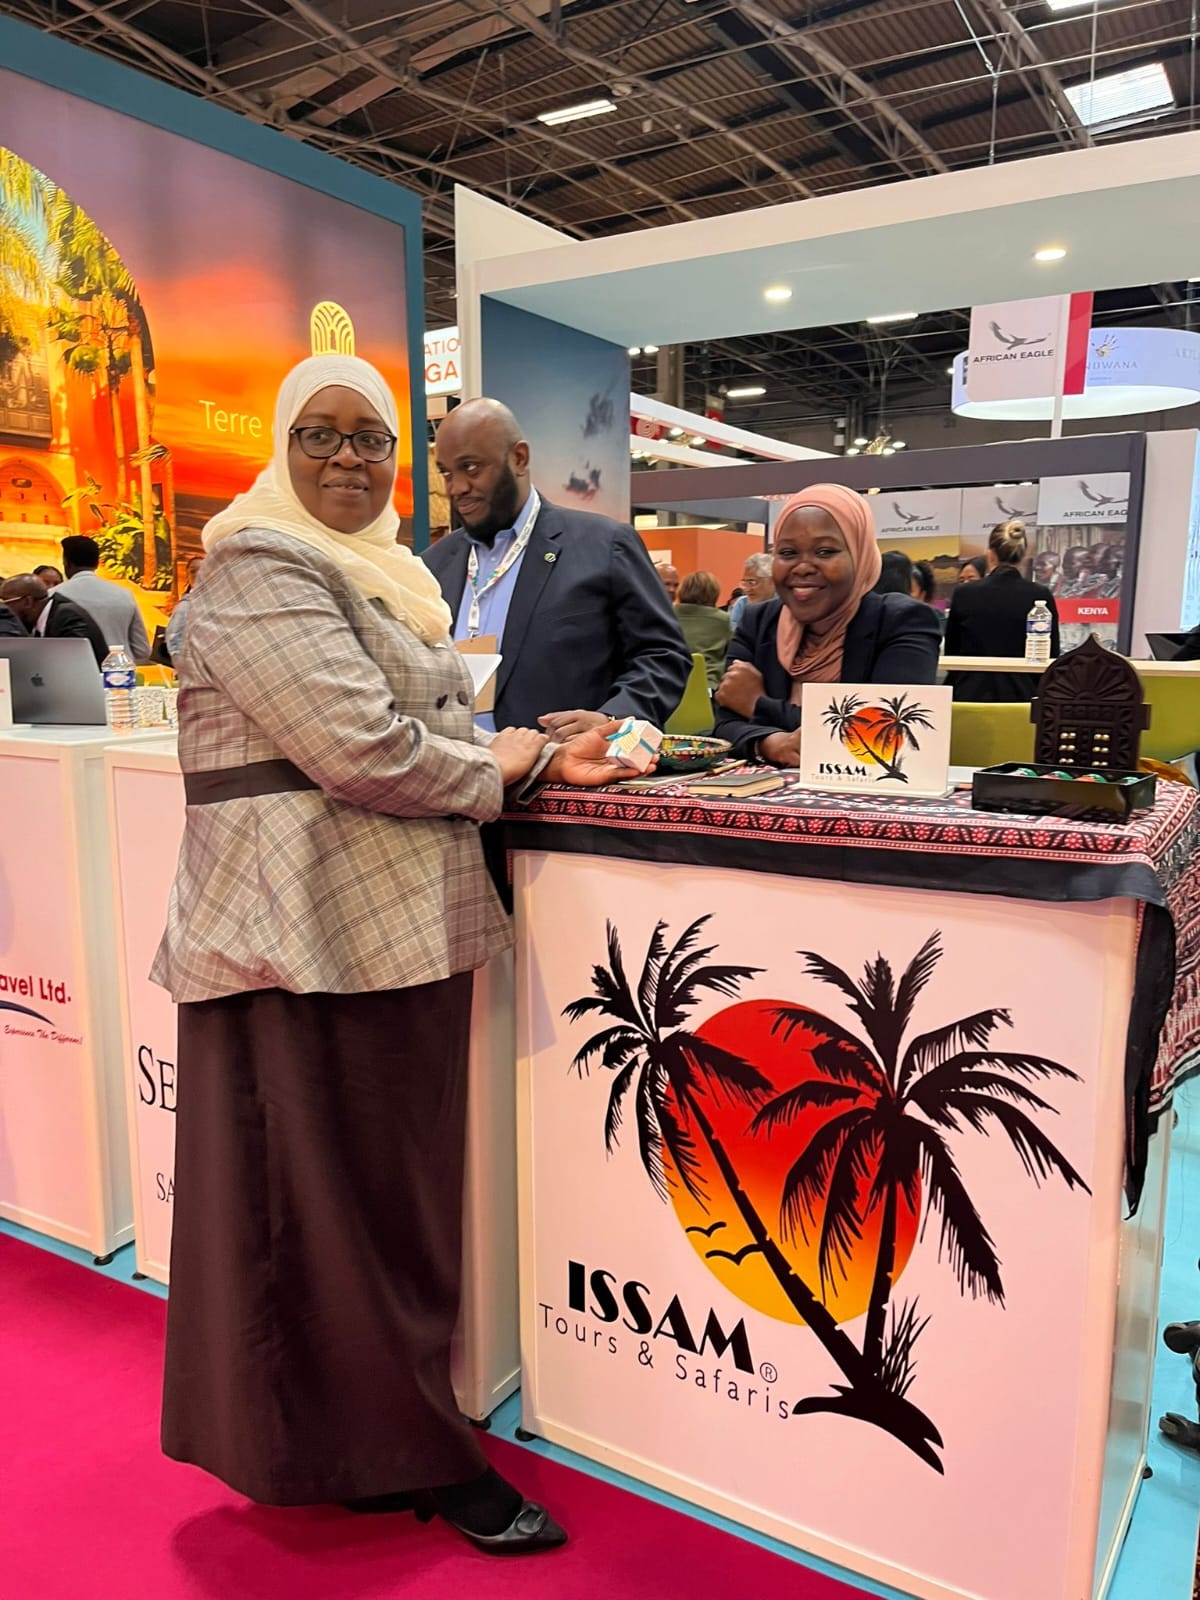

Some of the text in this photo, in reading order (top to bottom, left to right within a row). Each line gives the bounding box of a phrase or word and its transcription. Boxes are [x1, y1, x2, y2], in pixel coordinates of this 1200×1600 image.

[424, 338, 461, 356] ATIO
[973, 349, 1054, 363] AFRICAN EAGLE
[199, 399, 263, 438] Terre
[1063, 510, 1104, 518] AFRICAN
[1077, 607, 1109, 615] KENYA
[819, 763, 867, 777] ISSAM
[39, 977, 72, 1004] Ltd.
[568, 1259, 755, 1375] ISSAM
[538, 1302, 789, 1420] Tours & Safaris
